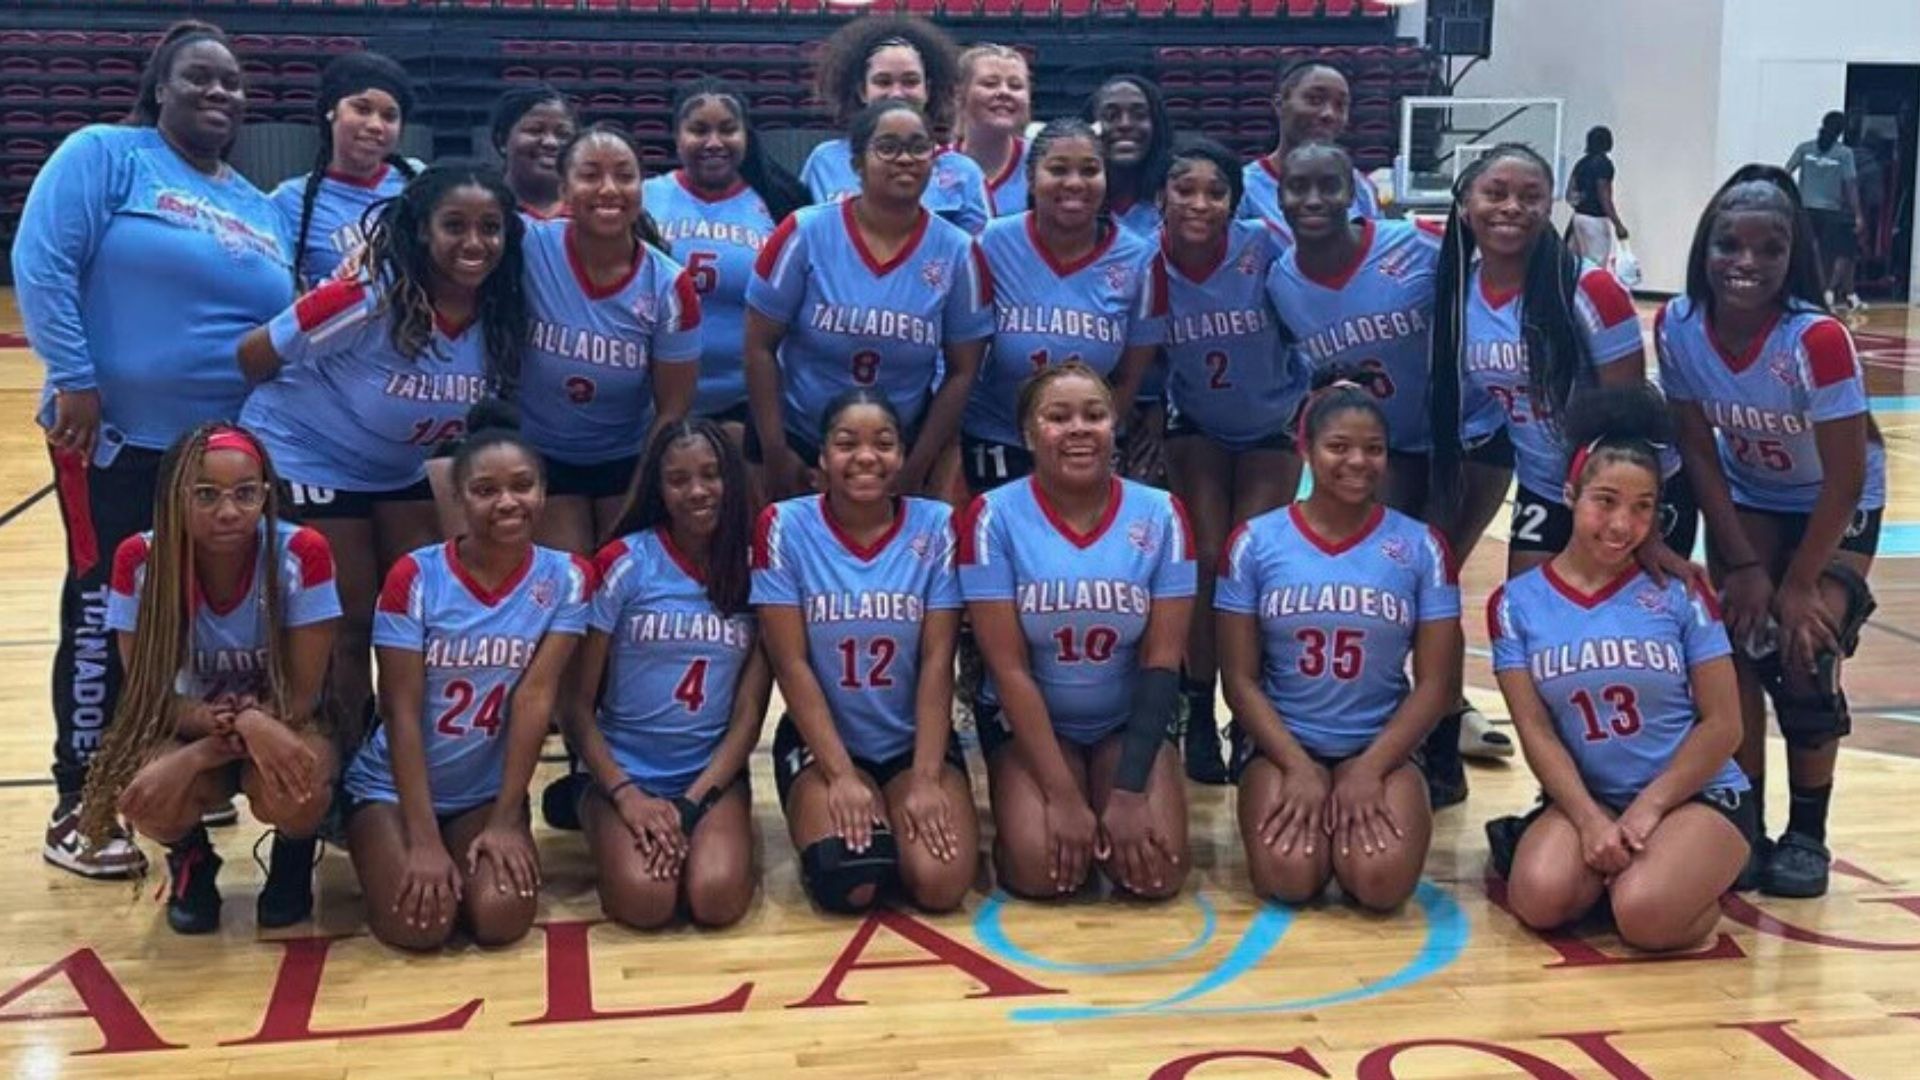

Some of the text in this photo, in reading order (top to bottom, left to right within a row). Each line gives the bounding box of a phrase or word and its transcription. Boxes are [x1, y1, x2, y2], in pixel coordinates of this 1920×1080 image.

[688, 250, 718, 295] 5
[810, 302, 938, 346] TALLADEGA
[997, 304, 1122, 343] TALLADEGA
[1205, 350, 1233, 390] 2
[972, 443, 1008, 478] 11
[836, 636, 897, 690] 12
[1051, 624, 1121, 666] 10
[1294, 626, 1367, 682] 35
[671, 655, 712, 715] 4
[436, 678, 508, 739] 24
[1569, 682, 1643, 743] 13
